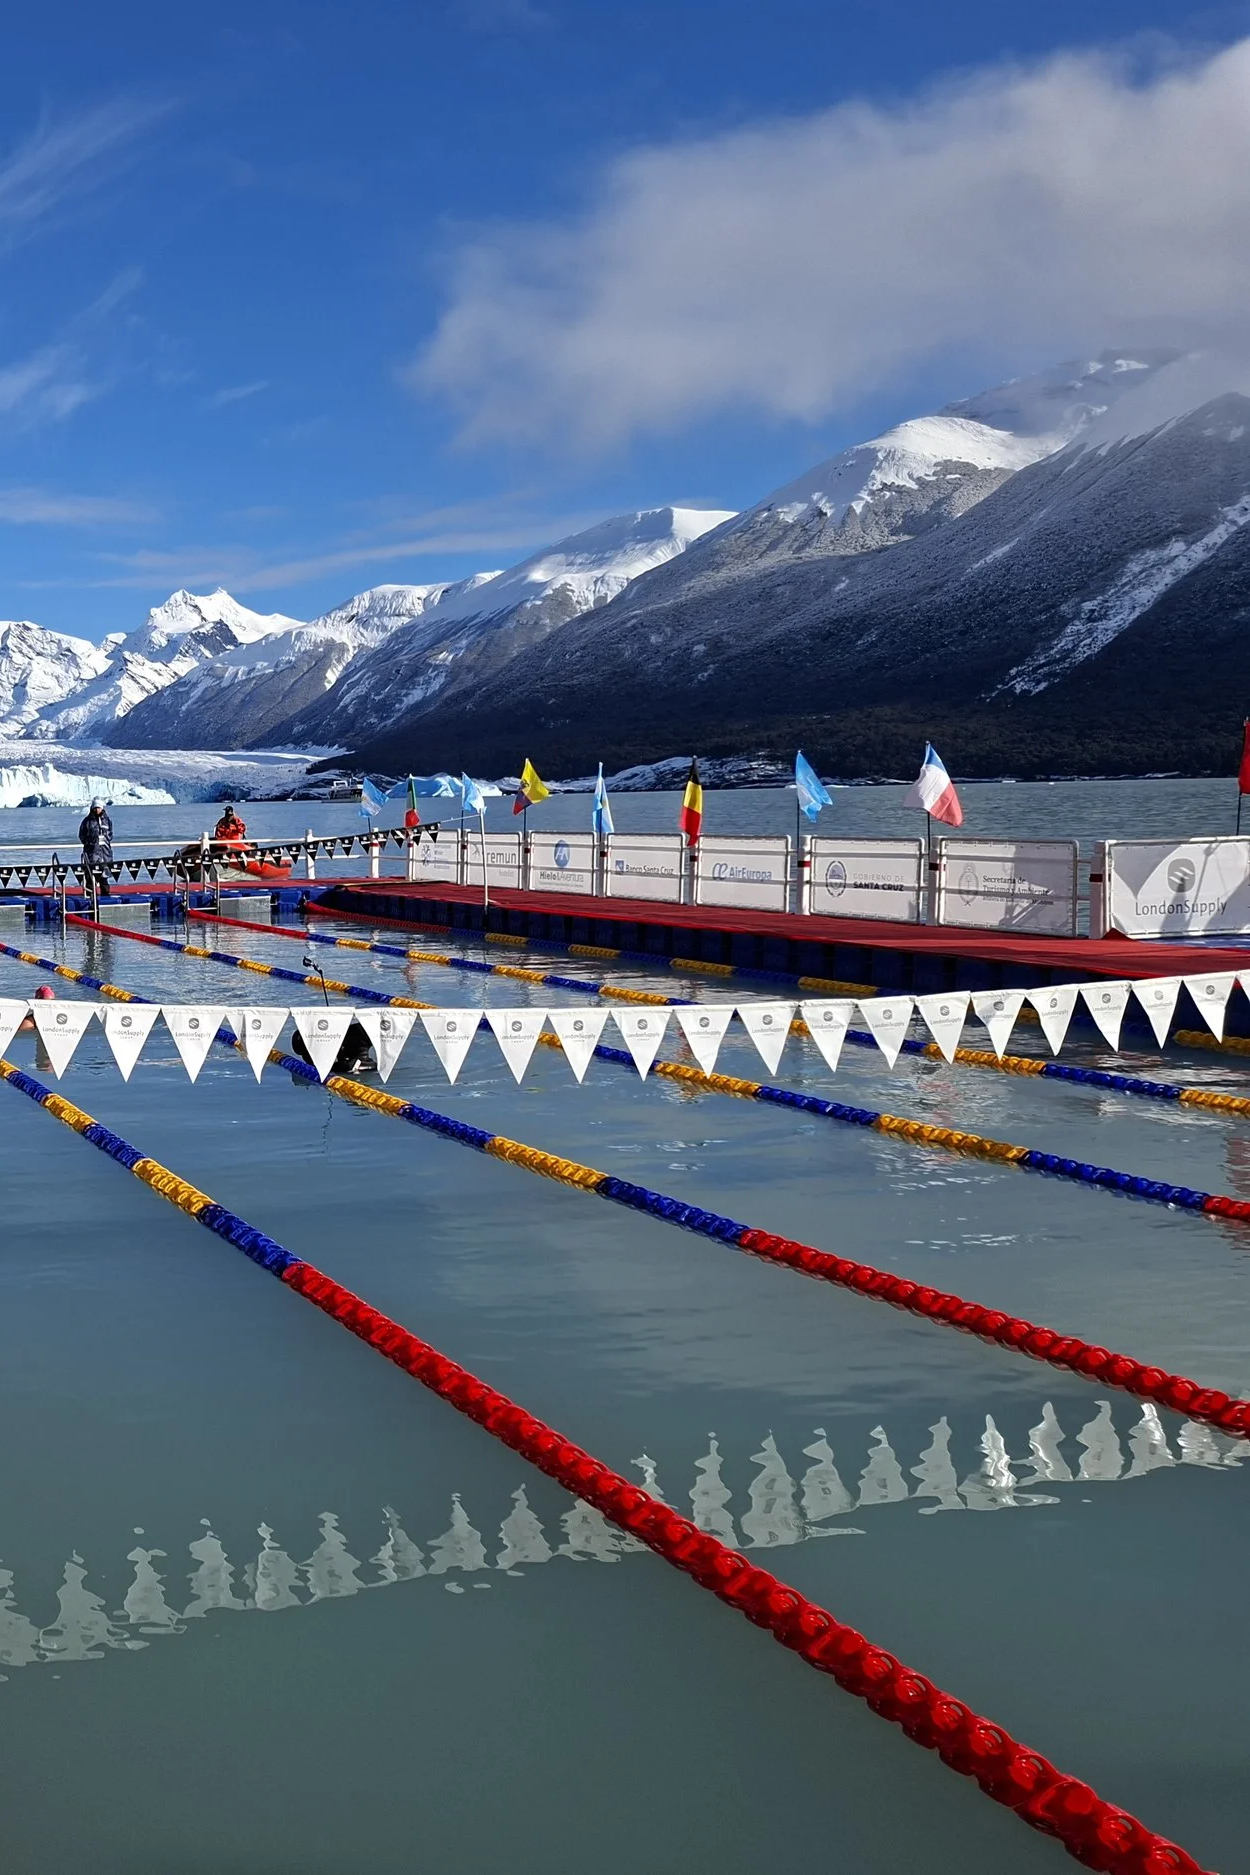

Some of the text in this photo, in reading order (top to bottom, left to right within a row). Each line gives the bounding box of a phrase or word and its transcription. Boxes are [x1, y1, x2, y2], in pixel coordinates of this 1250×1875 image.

[626, 864, 674, 875] Banco Santa Cruz
[853, 873, 892, 882] GOBIERNO
[1017, 876, 1026, 884] de
[853, 881, 904, 891] SANTA CRUZ
[1135, 897, 1227, 916] LondonSupply
[42, 1026, 80, 1034] LondonSupply
[305, 1032, 342, 1040] LondonSupply
